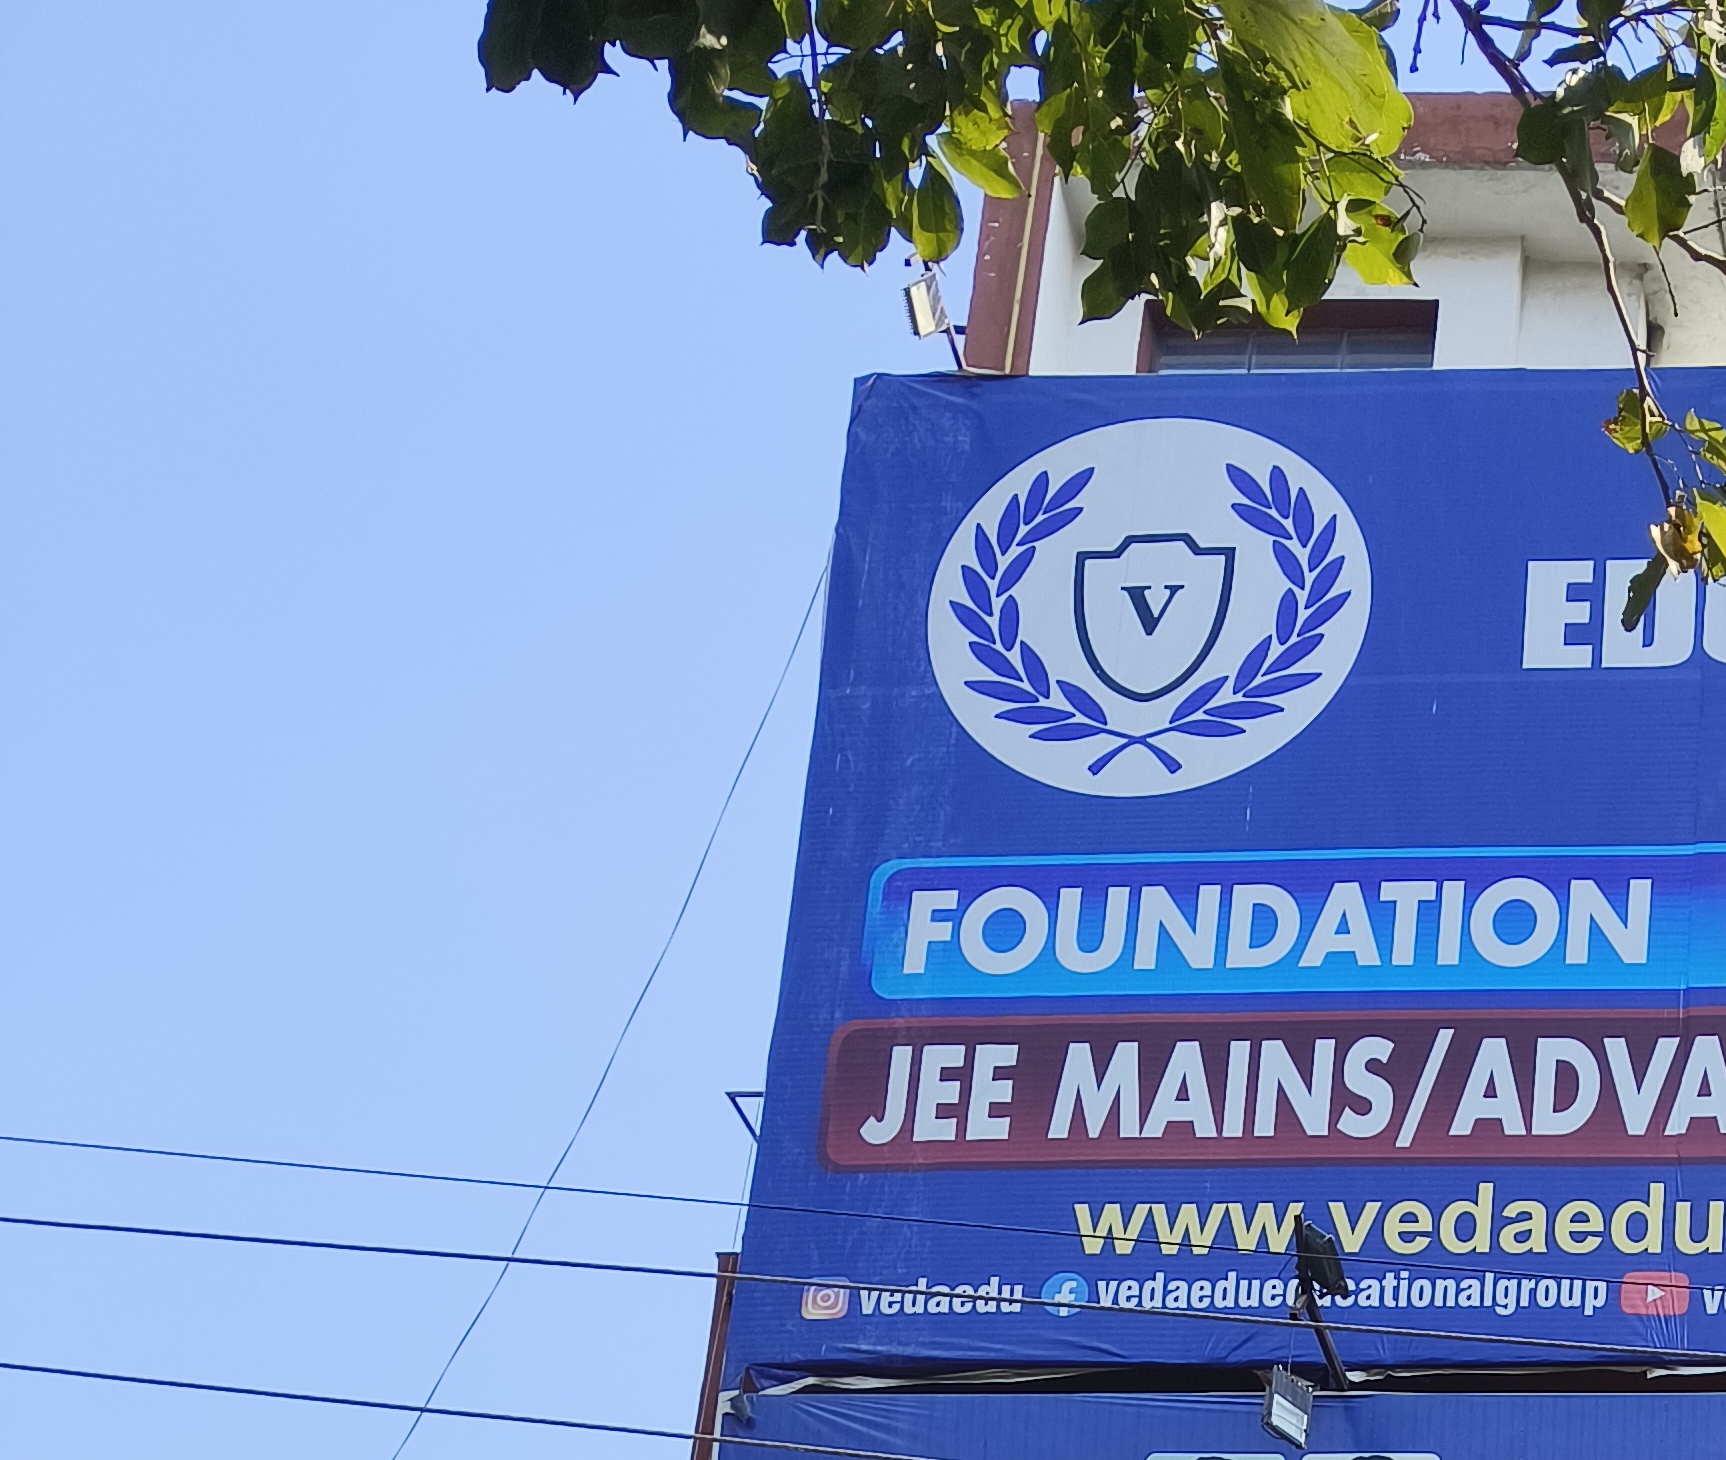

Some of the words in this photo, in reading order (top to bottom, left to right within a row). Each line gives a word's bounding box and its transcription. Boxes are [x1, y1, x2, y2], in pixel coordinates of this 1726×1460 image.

[1120, 583, 1184, 637] V
[902, 875, 1654, 975] FOUNDATION
[859, 1042, 1020, 1146] JEE
[859, 1275, 1024, 1315] vedaedu
[1097, 1270, 1608, 1316] vedaeduecationalgroup
